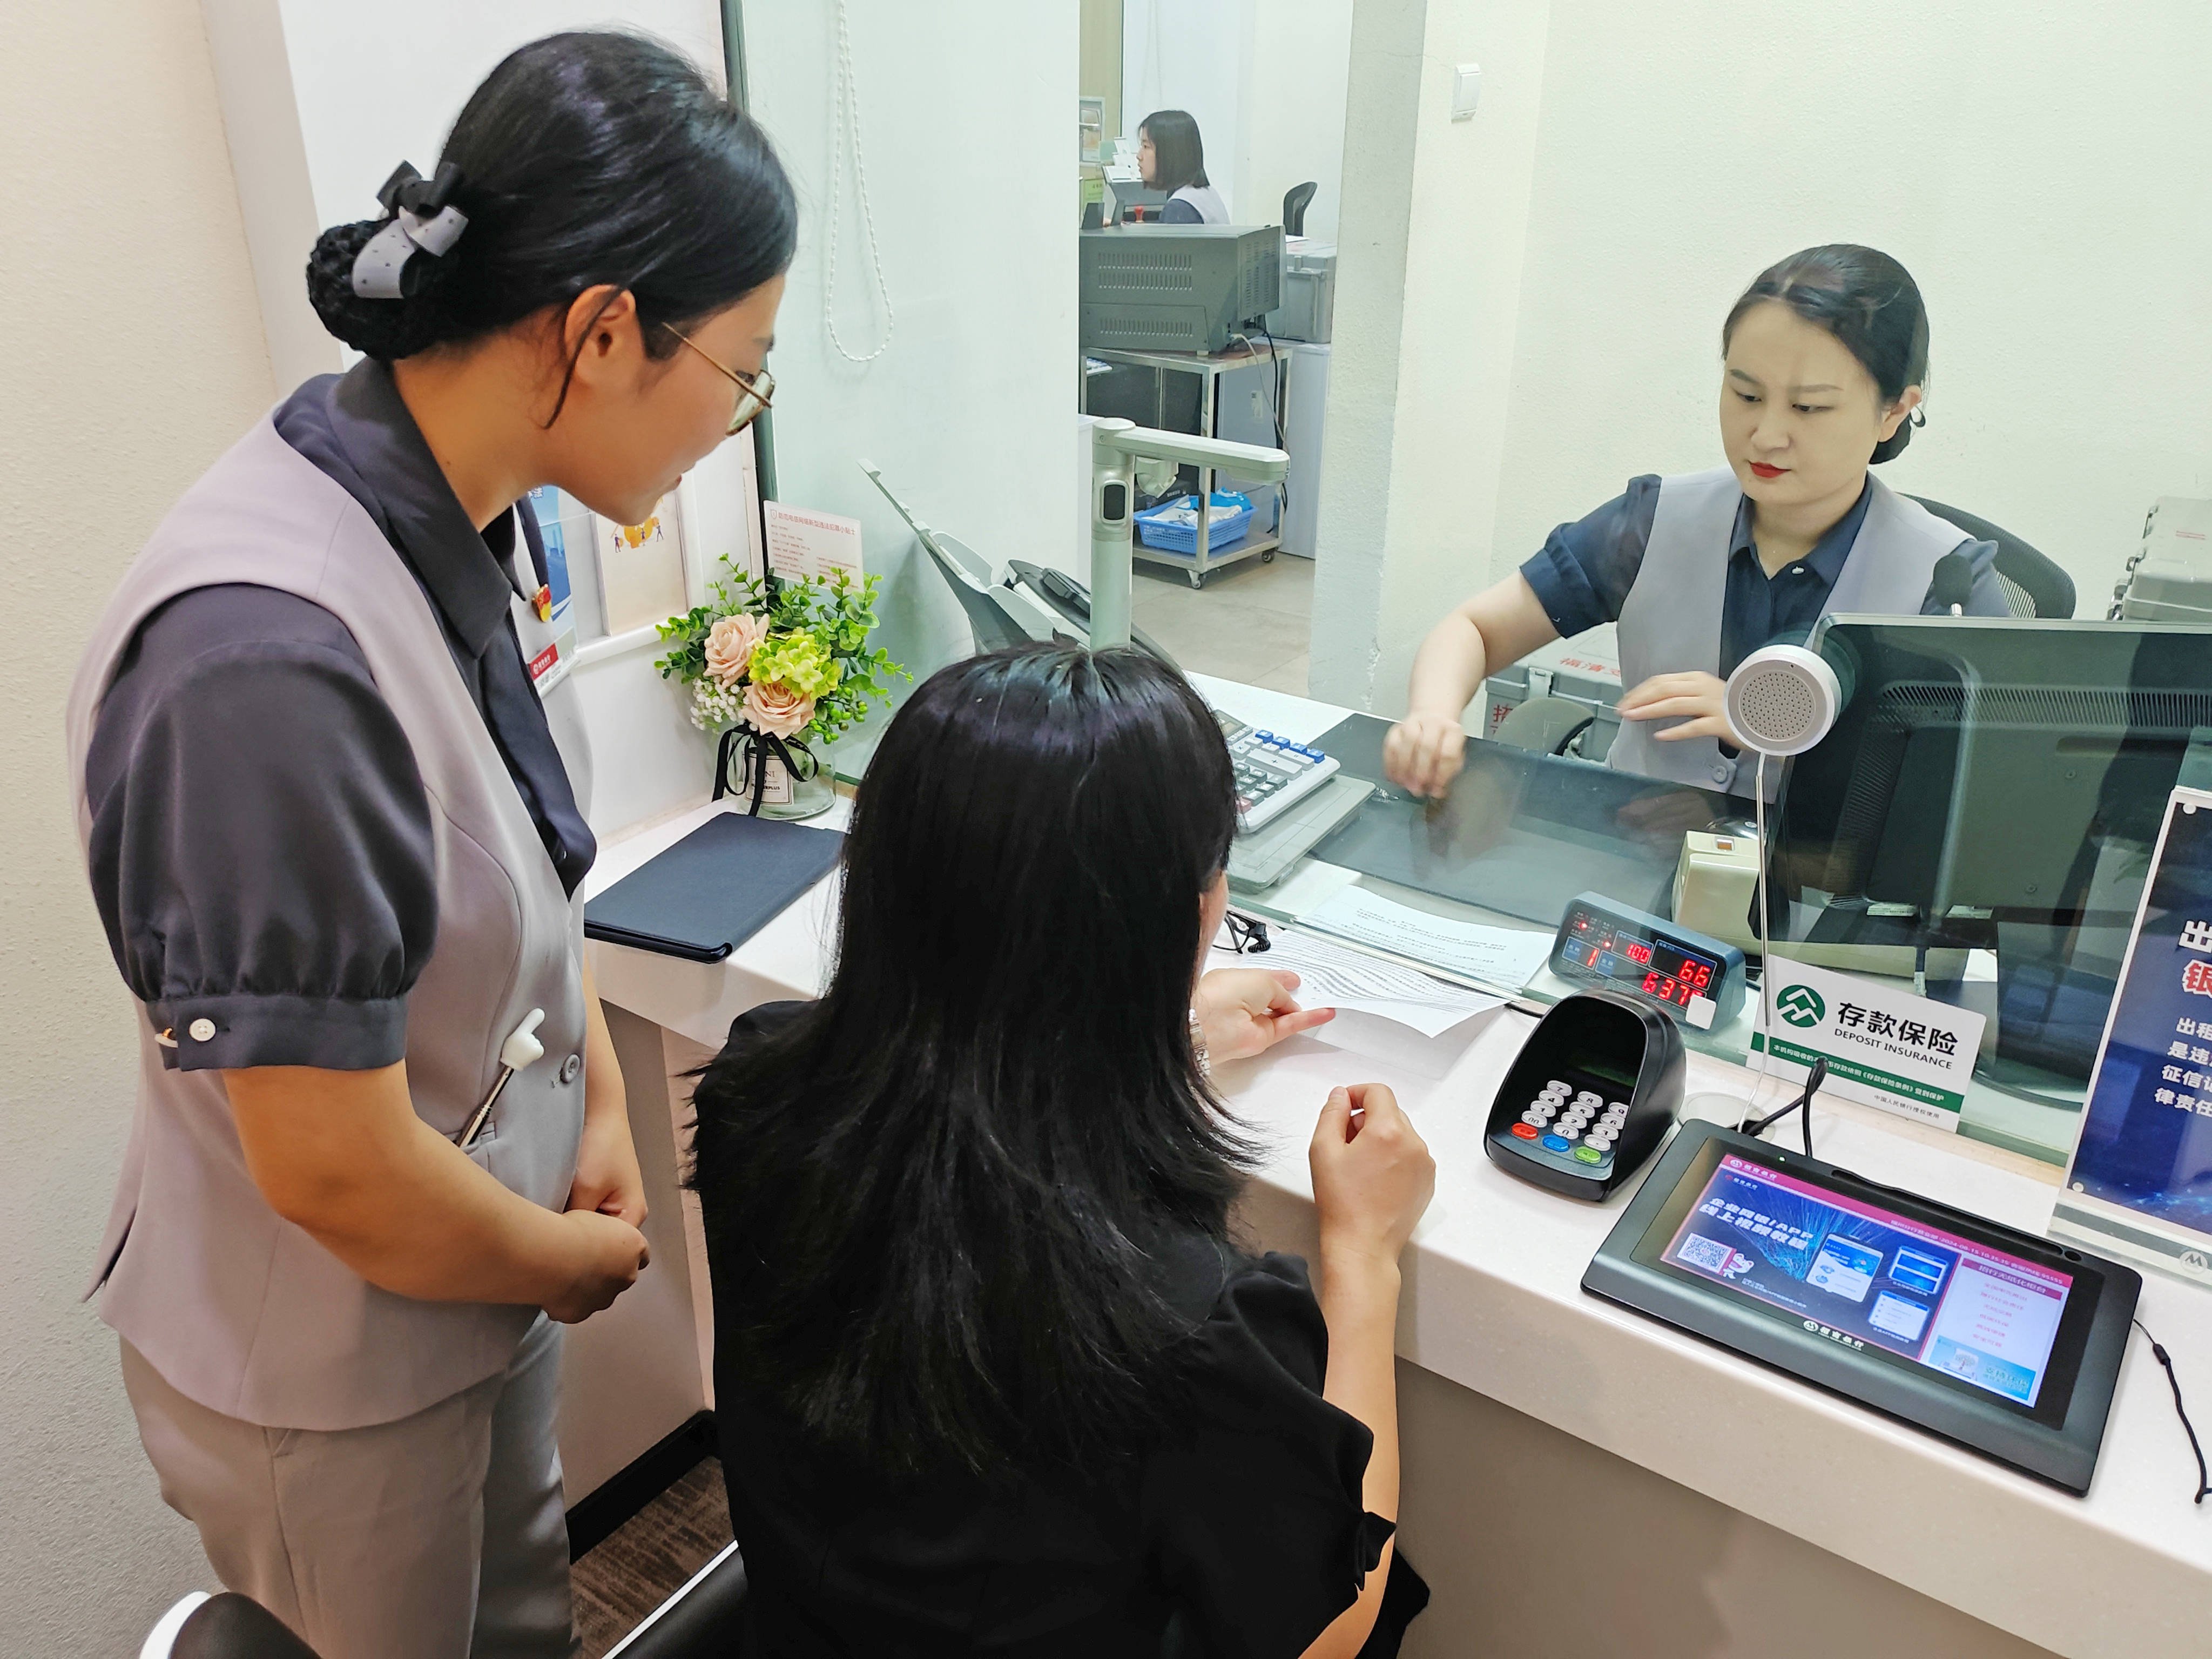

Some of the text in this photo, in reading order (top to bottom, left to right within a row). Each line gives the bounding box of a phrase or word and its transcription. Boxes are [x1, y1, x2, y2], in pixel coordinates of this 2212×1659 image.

[1587, 948, 1599, 967] 1
[1626, 943, 1651, 963] 100
[1678, 959, 1711, 987] 66
[1837, 1002, 1958, 1056] 存款保险
[1834, 1028, 1953, 1070] DEPOSIT INSURANCE
[2167, 1040, 2212, 1067] 是违
[1874, 1095, 1940, 1119] 中国人民银行授权使用
[1709, 1197, 1815, 1239] 企业网银/APP
